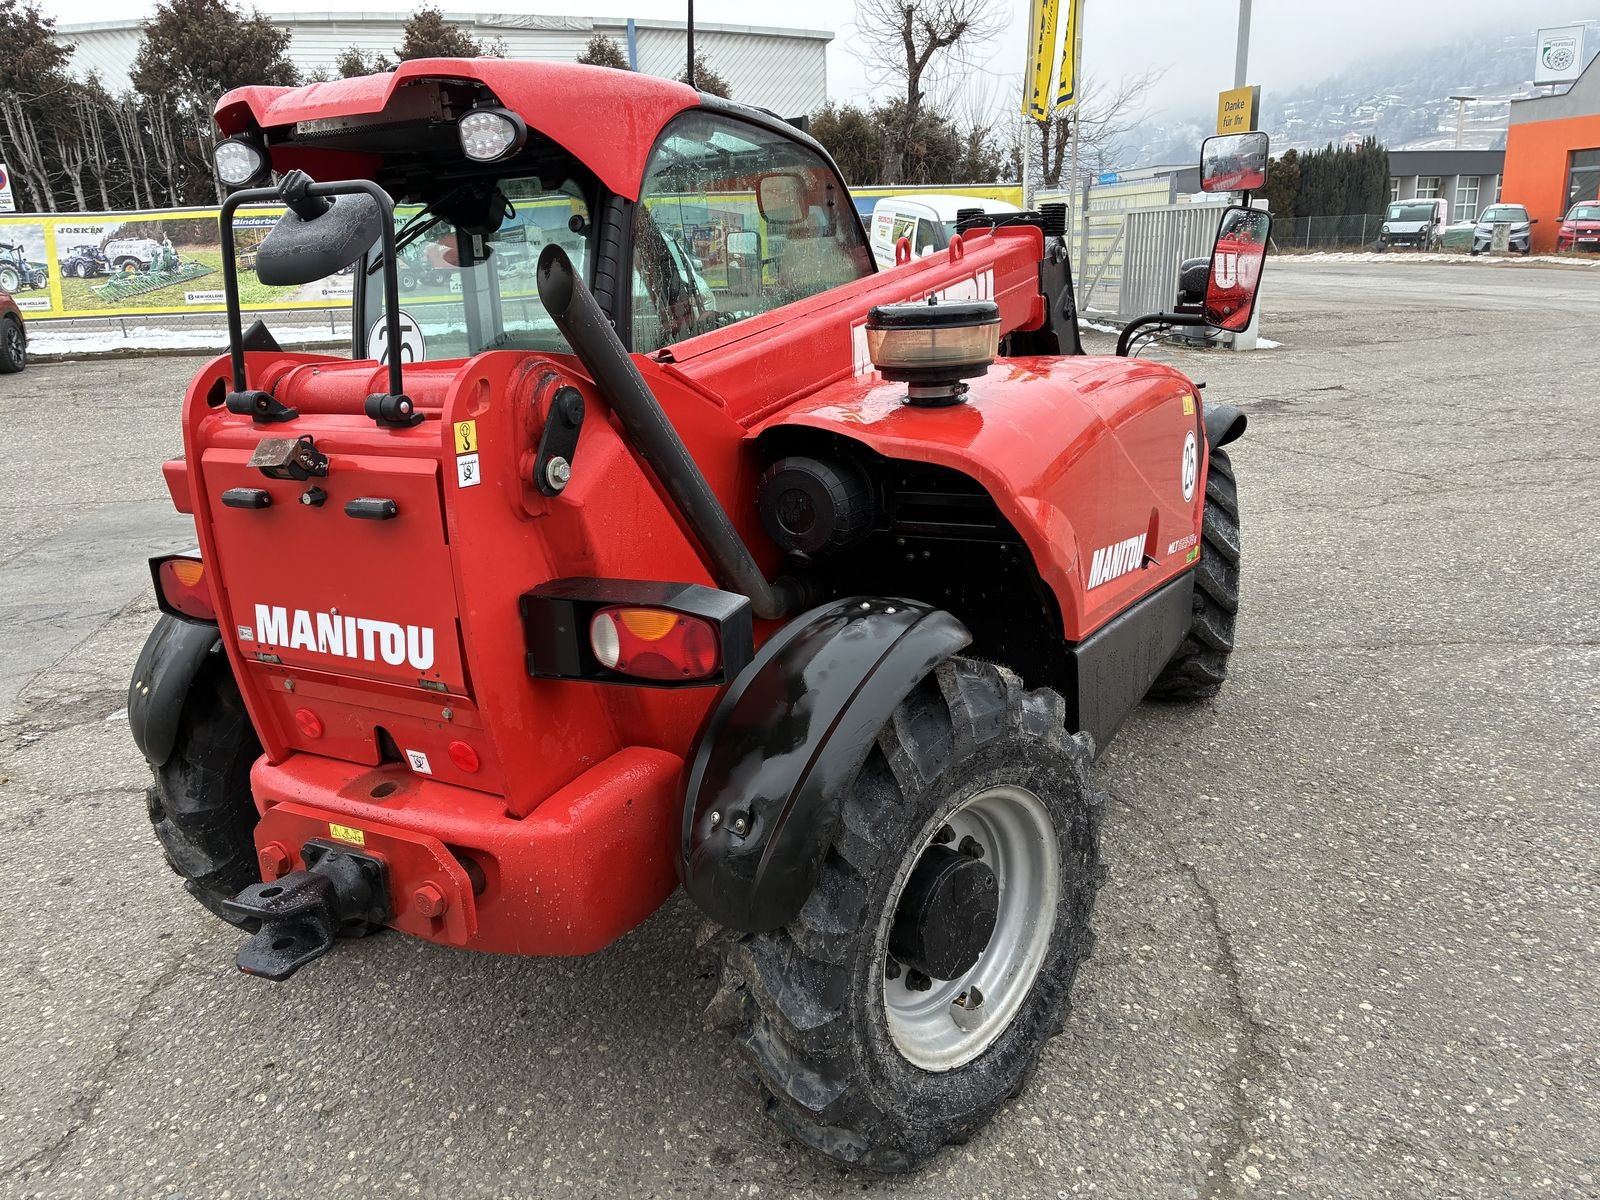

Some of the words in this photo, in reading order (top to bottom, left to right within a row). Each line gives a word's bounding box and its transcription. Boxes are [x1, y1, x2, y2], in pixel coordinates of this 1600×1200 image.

[1223, 114, 1232, 128] für
[1233, 114, 1244, 126] Ihr
[1224, 98, 1245, 112] Danke
[1184, 442, 1195, 491] 25
[1087, 532, 1147, 591] MANITOU
[254, 603, 435, 671] MANITOU
